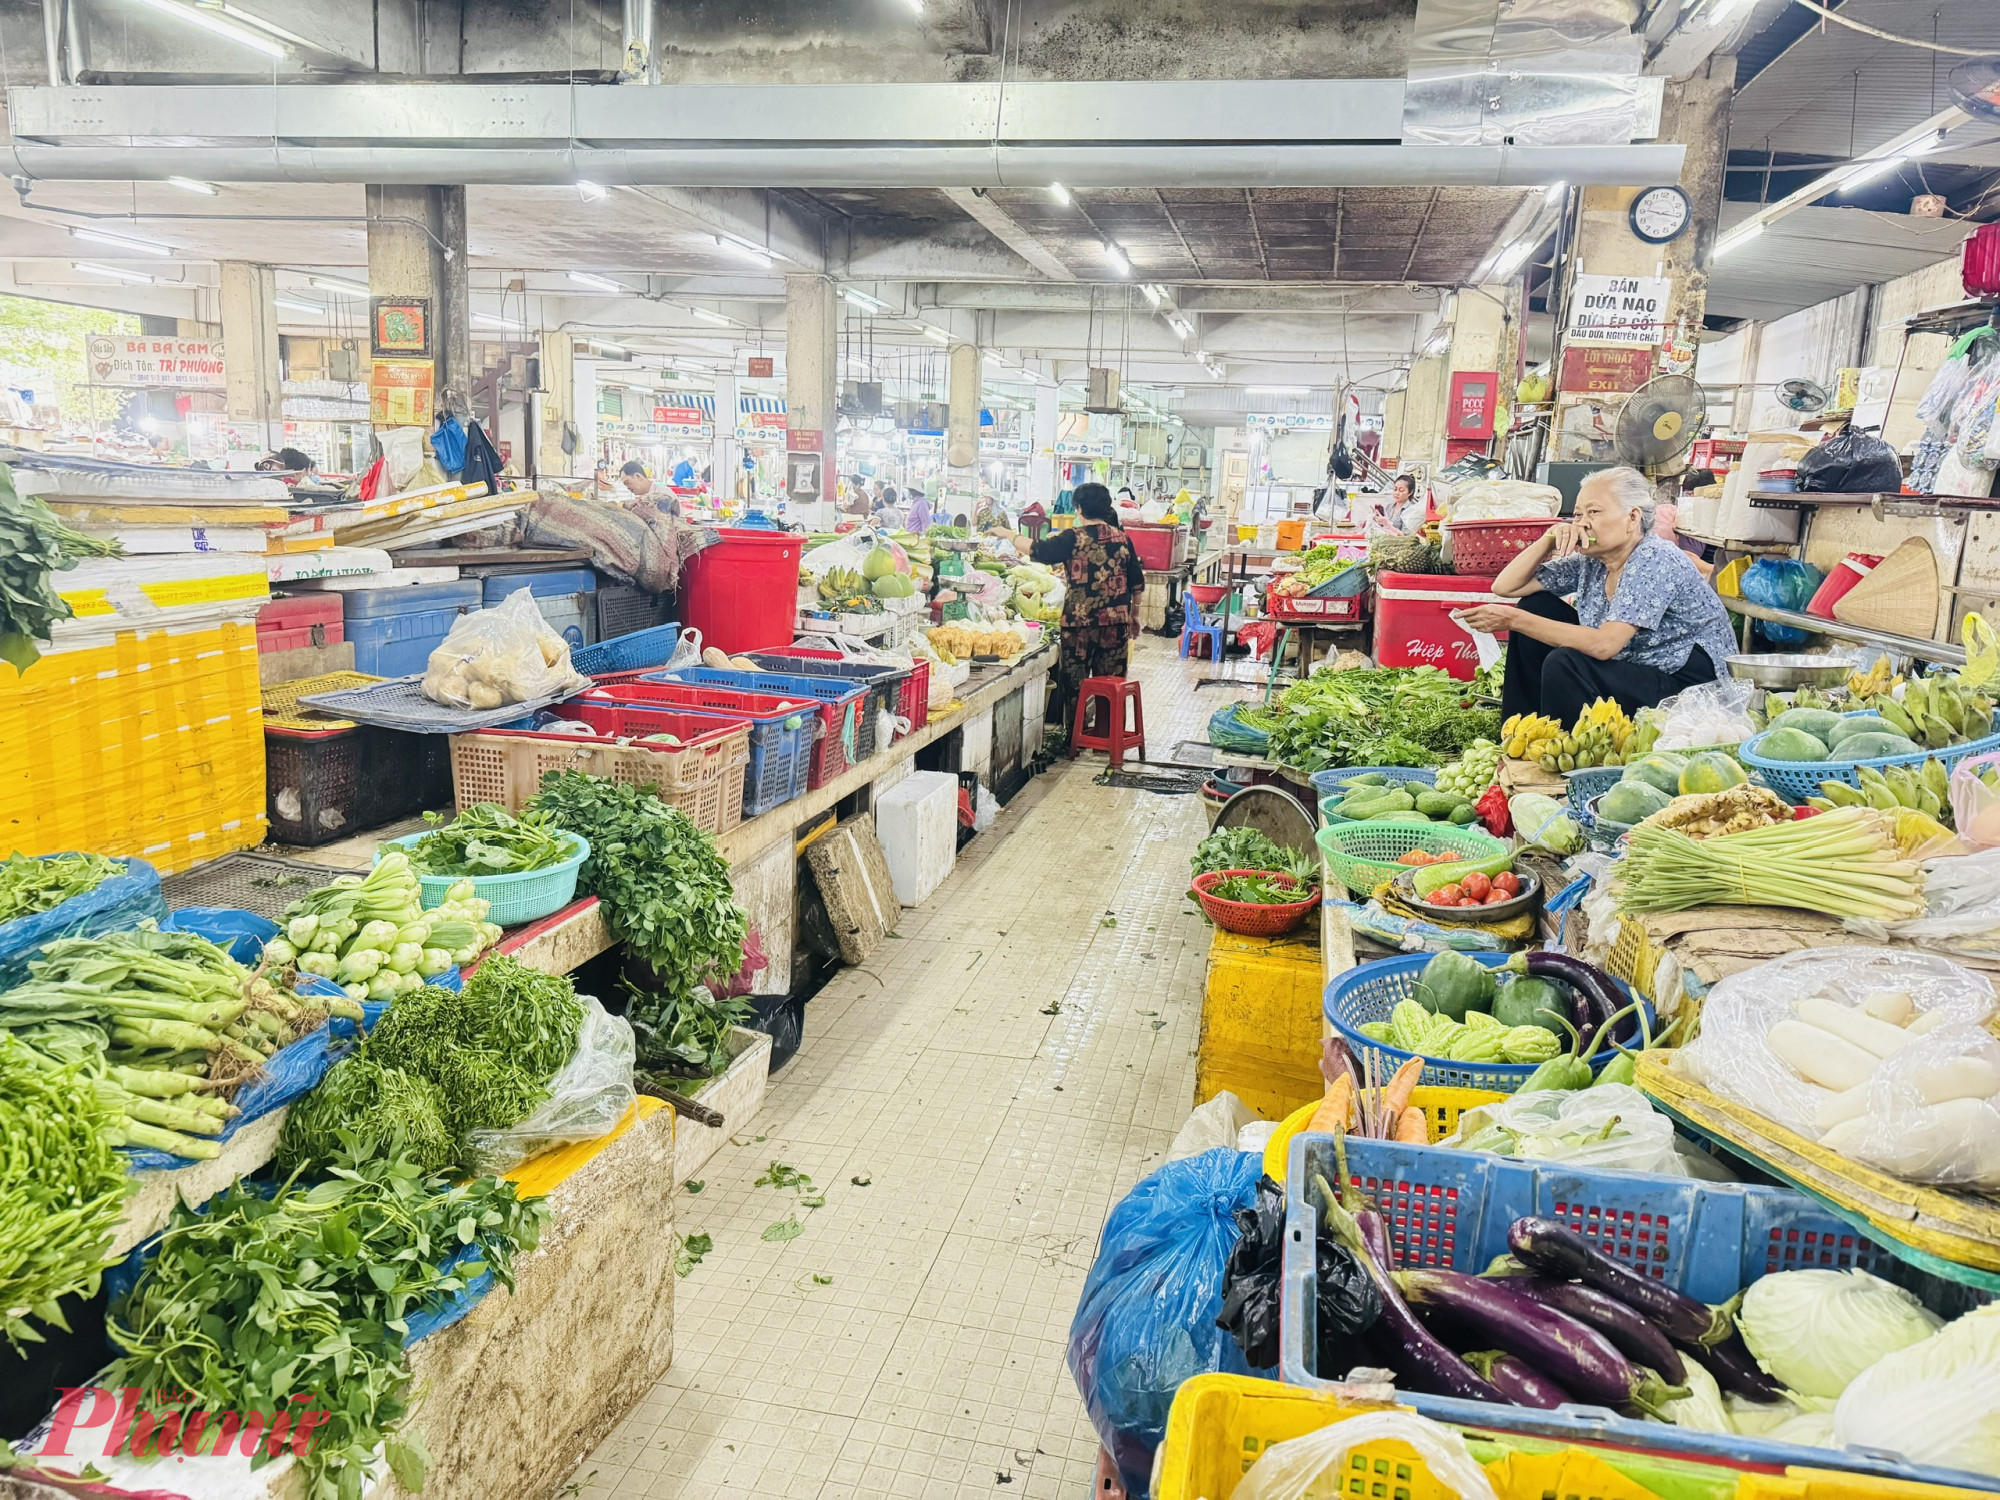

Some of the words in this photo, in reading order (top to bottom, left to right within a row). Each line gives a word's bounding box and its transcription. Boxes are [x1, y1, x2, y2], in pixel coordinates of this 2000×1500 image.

[1609, 278, 1639, 293] BÁN
[1585, 293, 1617, 309] DỪA
[1623, 298, 1657, 315] NẠO
[1578, 312, 1605, 326] DỪA
[1610, 314, 1627, 328] ÉP
[1588, 329, 1604, 338] DỪA
[1606, 330, 1638, 340] NGUYÊN
[1639, 331, 1660, 342] CHẤT
[114, 359, 133, 371] Đích
[159, 357, 177, 373] TRÍ
[1588, 381, 1619, 389] EXIT
[1462, 399, 1485, 408] PCCC
[1406, 639, 1445, 662] Hiệp
[1451, 641, 1481, 660] Tha
